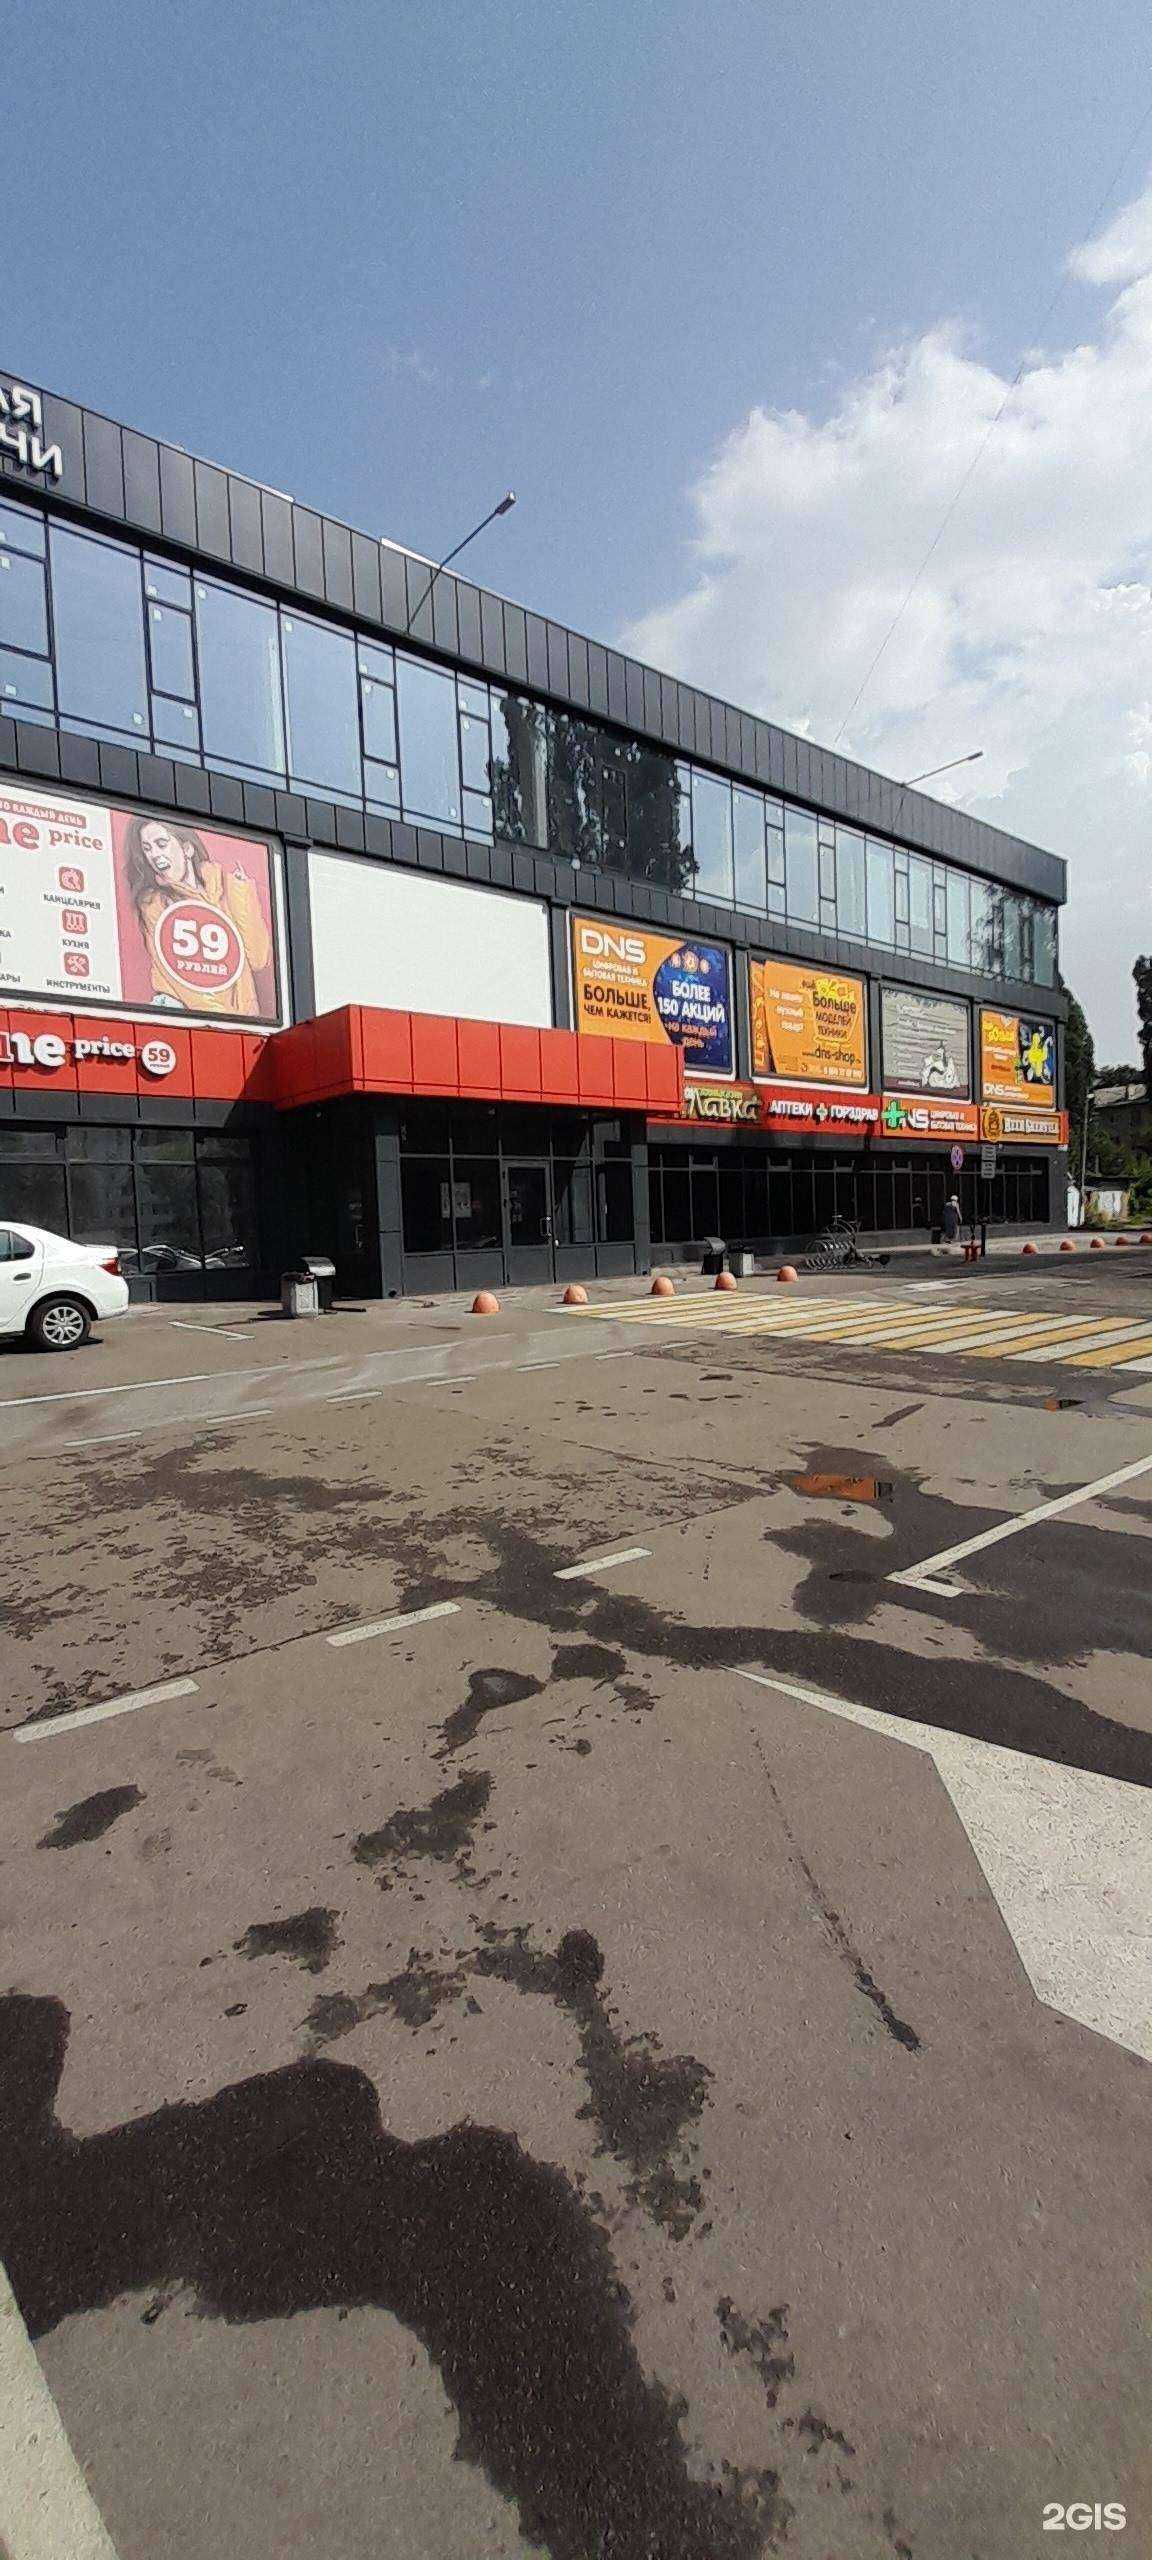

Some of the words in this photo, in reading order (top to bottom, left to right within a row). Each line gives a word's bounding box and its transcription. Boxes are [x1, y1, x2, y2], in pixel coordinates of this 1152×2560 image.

[48, 829, 104, 851] price
[43, 893, 101, 910] КАНЦЕЛЯРИЯ
[62, 938, 90, 949] КУХНЯ
[172, 918, 229, 961] 59
[581, 927, 646, 964] DNS
[177, 959, 229, 976] РУБЛЕЙ
[46, 979, 111, 994] ИНСТРУМЕНТЫ
[583, 983, 651, 1012] БОЛЬШЕ,
[672, 980, 711, 1002] БОЛЕЕ
[583, 1003, 604, 1017] ЧЕМ
[657, 997, 679, 1016] 150
[681, 1001, 726, 1024] АКЦИЙ
[74, 1036, 136, 1059] price
[148, 1047, 170, 1062] 59
[769, 1100, 813, 1117] АПТЕКИ
[830, 1105, 879, 1121] ГОРЗДРАВ
[899, 1103, 929, 1130] NS
